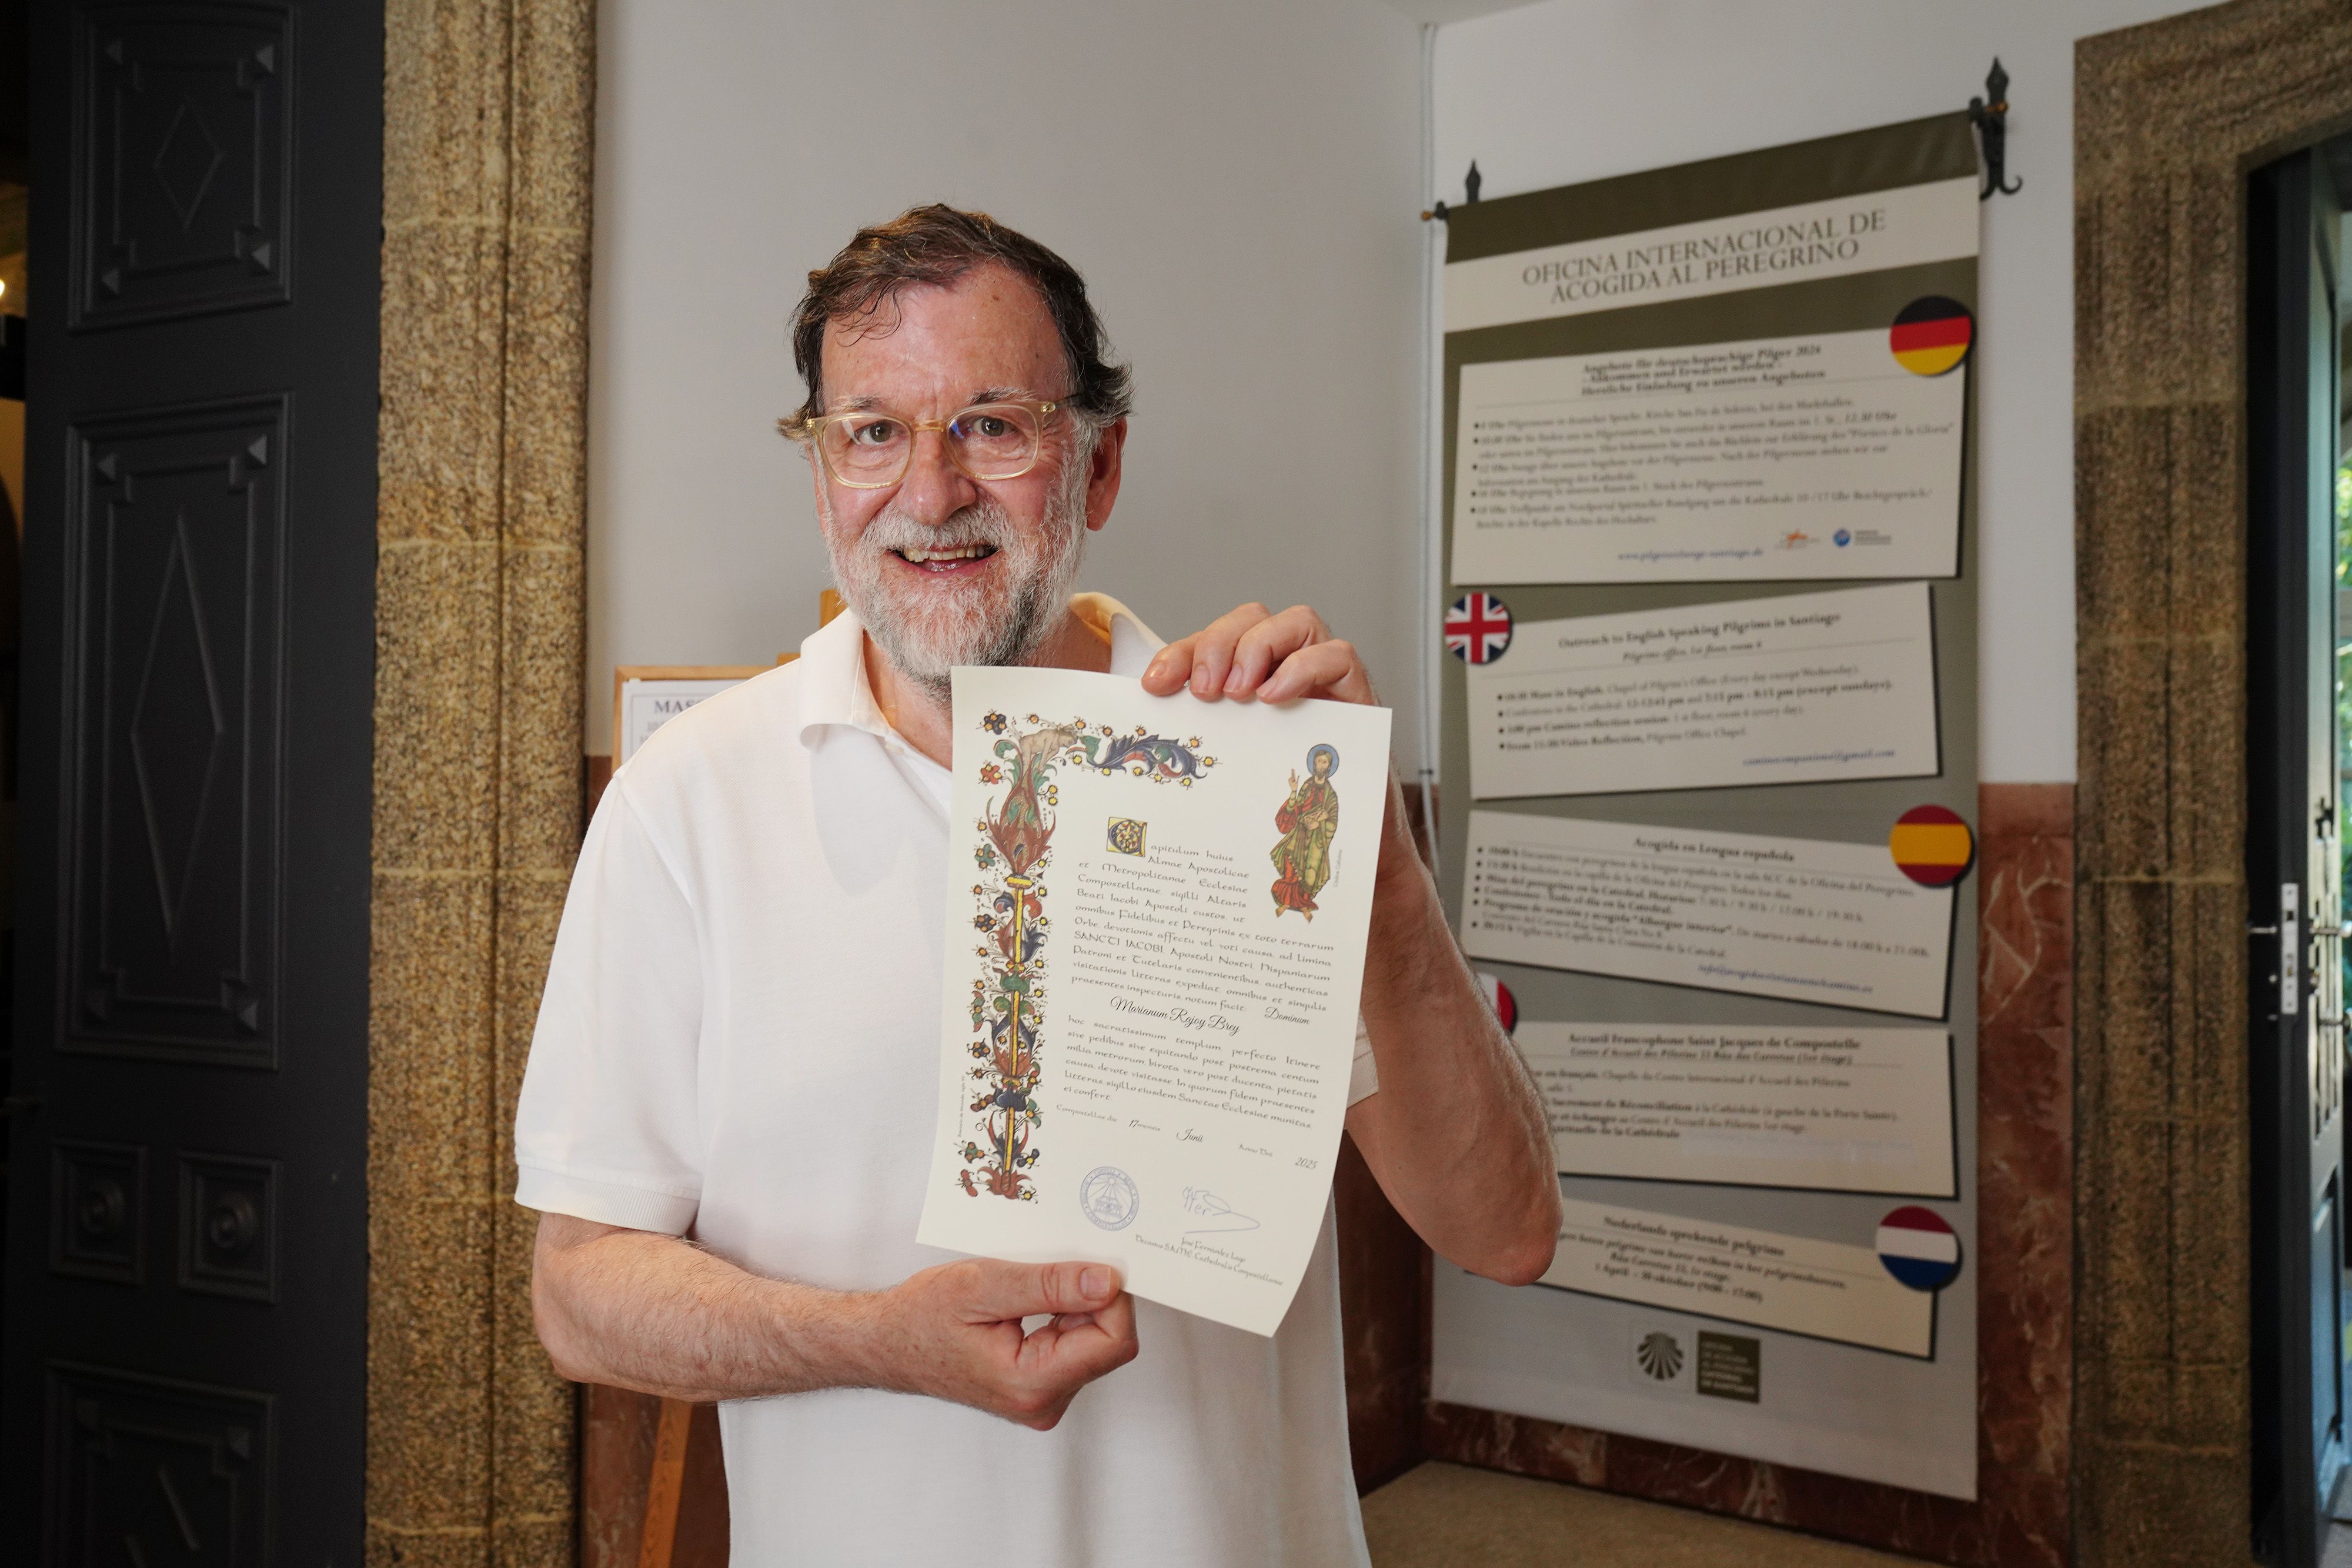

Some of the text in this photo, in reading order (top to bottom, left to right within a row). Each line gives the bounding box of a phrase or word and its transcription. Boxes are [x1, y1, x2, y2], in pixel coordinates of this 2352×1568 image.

[1522, 210, 1886, 286] OFICINA INTERNACIONAL DE
[1551, 239, 1860, 303] ACOGIDA AL PEREGRINO
[1626, 629, 1666, 644] English
[654, 699, 704, 713] MAS
[1147, 855, 1250, 878] Almae Apostolicae
[1206, 850, 1234, 862] huius
[1101, 862, 1186, 884] Metropolitanae
[1199, 878, 1248, 894] Ecclesiae
[1171, 890, 1198, 902] sigilli
[1207, 894, 1247, 908] Altaris
[1077, 888, 1104, 900] Beati
[1144, 899, 1187, 914] Apostoli
[1074, 930, 1120, 946] SANCTI
[1170, 947, 1213, 962] Apostoli
[1075, 905, 1115, 916] omnibus
[1119, 909, 1165, 924] Fidelibus
[1182, 920, 1235, 936] Peregrinis
[1255, 934, 1277, 943] toto
[1281, 938, 1334, 951] terrarum
[1103, 921, 1153, 937] devotionis
[1157, 931, 1194, 944] affectu
[1200, 938, 1214, 947] vel
[1279, 952, 1292, 961] ad
[1073, 944, 1112, 959] Patroni
[1132, 954, 1182, 971] Tutelaris
[1265, 981, 1328, 997] authenticas
[1073, 961, 1127, 975] visitationis
[1226, 989, 1267, 1001] omnibus
[1288, 999, 1327, 1012] singulis
[1071, 976, 1124, 989] praesentes
[1185, 997, 1217, 1007] notum
[1264, 1007, 1310, 1025] Dominum
[1110, 996, 1240, 1036] Marianum Rajoy Brey
[1067, 1031, 1319, 1085] sive pedibus sive equitando post postrema centum
[1068, 1014, 1085, 1025] hoc
[1094, 1022, 1167, 1040] sacratissimum
[1231, 1049, 1277, 1061] perfecto
[1067, 1044, 1091, 1054] milia
[1148, 1058, 1180, 1072] birota
[1183, 1068, 1204, 1076] vero
[1207, 1073, 1229, 1082] post
[1277, 1086, 1317, 1099] pietatis
[1097, 1062, 1128, 1076] devote
[1177, 1078, 1186, 1087] In
[1188, 1084, 1227, 1095] quorum
[1230, 1089, 1258, 1102] fidem
[1260, 1098, 1315, 1114] praesentes
[1106, 1081, 1137, 1092] sigillo
[1137, 1087, 1177, 1099] eiusdem
[1178, 1092, 1220, 1108] Sanctae
[1221, 1102, 1269, 1119] Ecclesiae
[1128, 1119, 1139, 1128] 17
[1295, 1156, 1318, 1169] 2025
